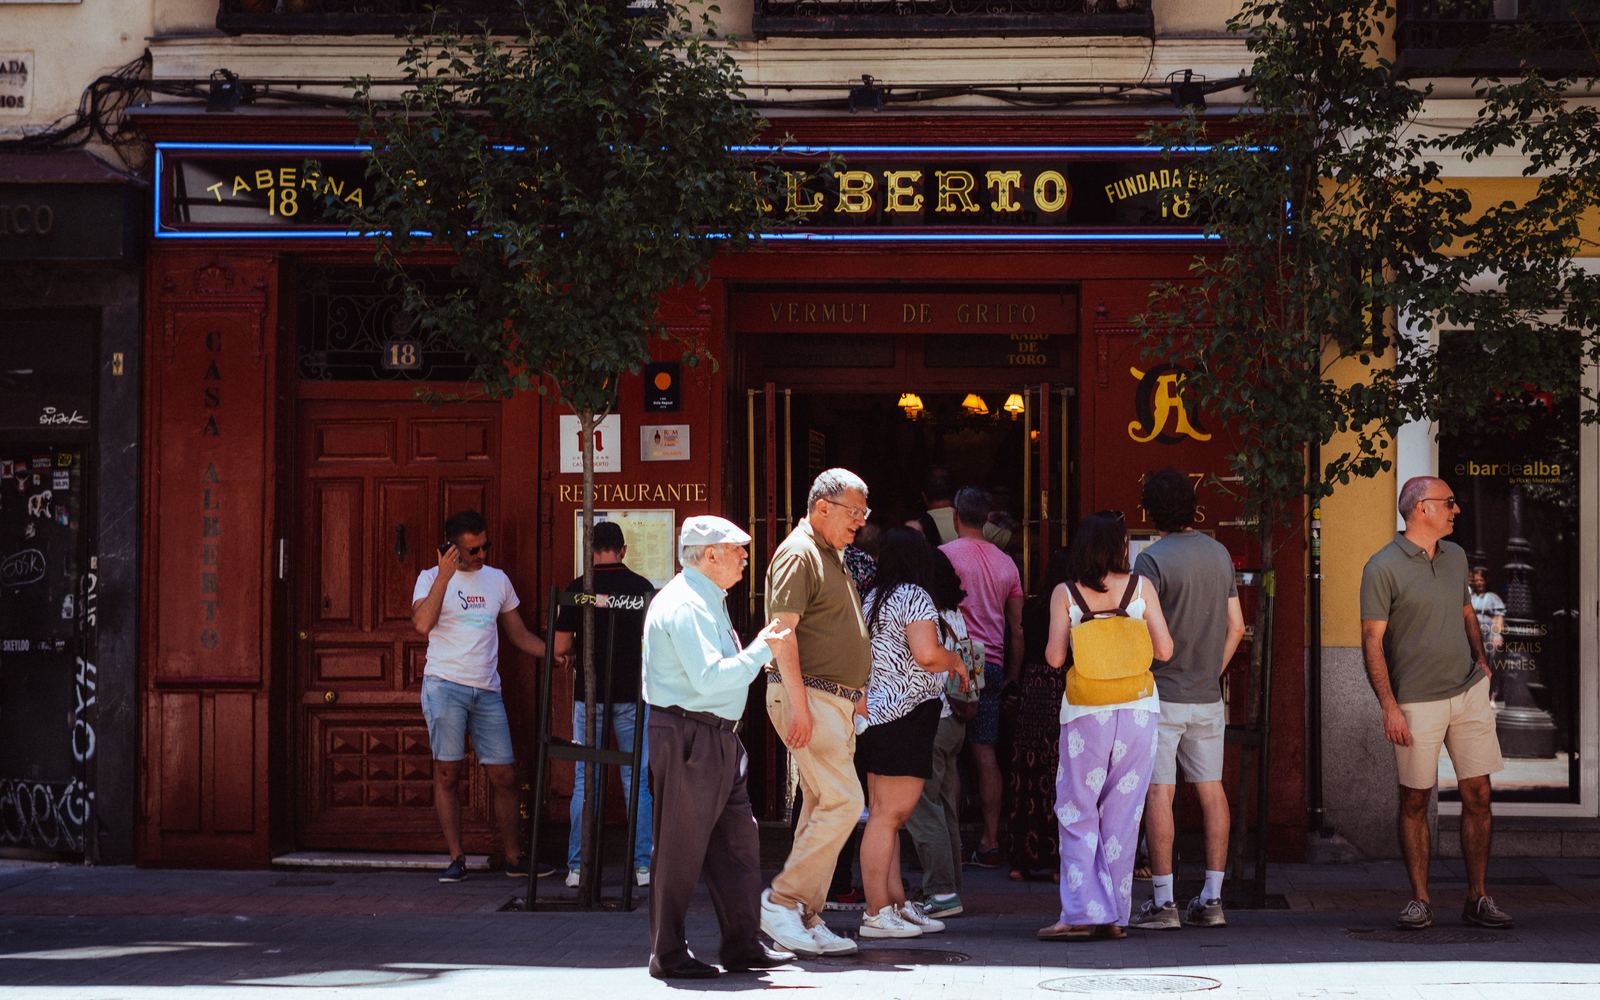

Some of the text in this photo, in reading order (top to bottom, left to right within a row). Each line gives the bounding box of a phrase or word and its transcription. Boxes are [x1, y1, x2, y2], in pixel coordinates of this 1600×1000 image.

[206, 167, 365, 209] TABERNA
[1104, 168, 1183, 204] FUNDADA
[267, 188, 299, 216] 18
[769, 303, 1036, 323] VERMUT DE GRIFO
[389, 344, 416, 367] 18
[1018, 342, 1039, 353] DE
[1007, 354, 1047, 366] TORO
[204, 331, 222, 437] CASA
[559, 483, 707, 503] RESTAURANTE
[200, 462, 220, 650] ALBERTO
[1480, 624, 1548, 636] OOD VIBES
[1484, 642, 1542, 653] OCKTAILS
[1493, 659, 1536, 671] WINES
